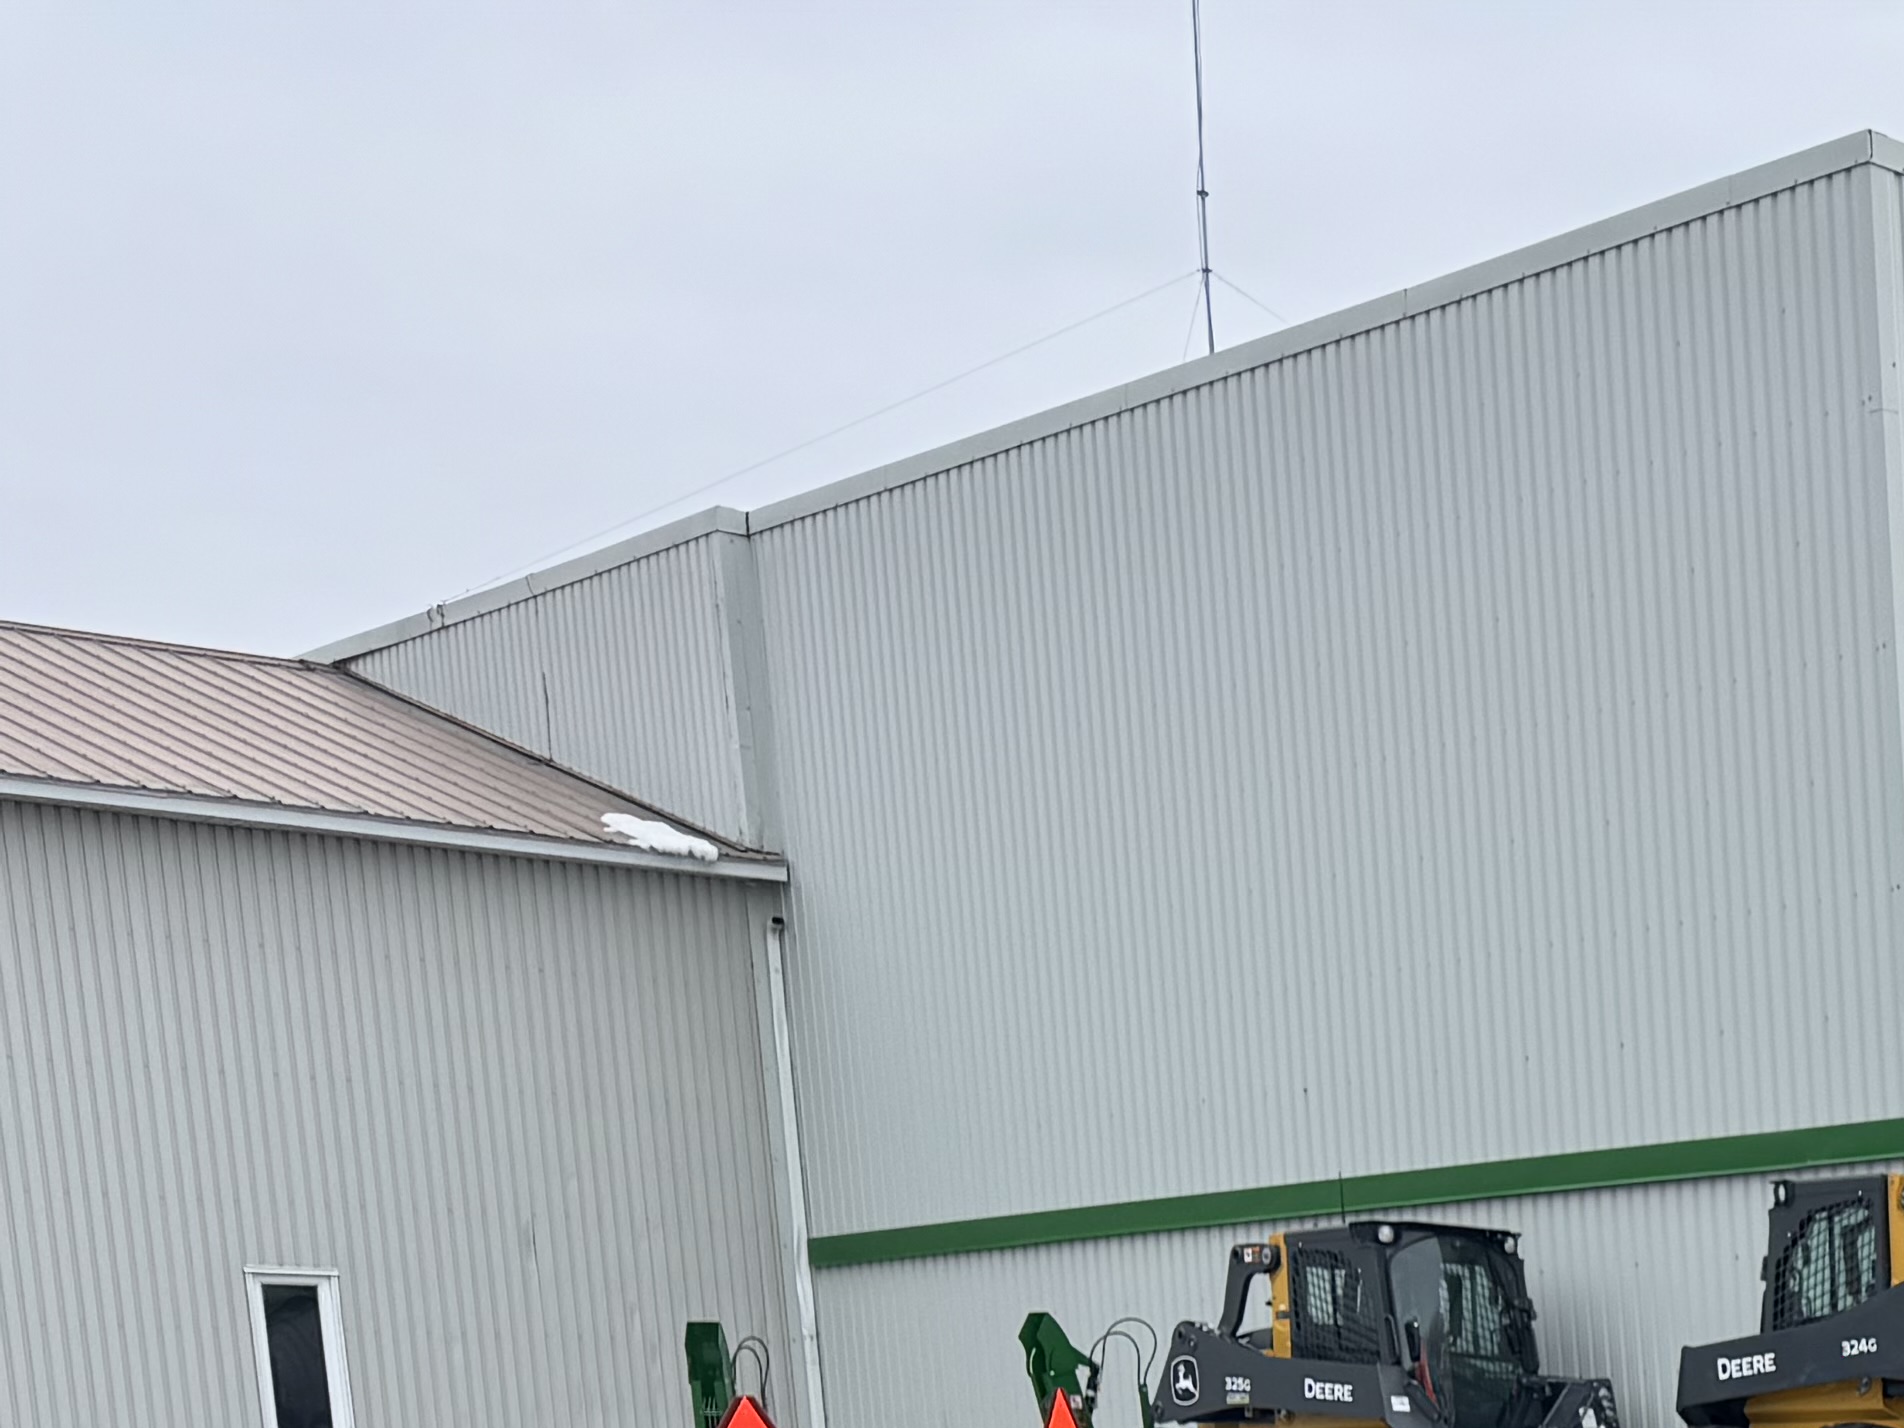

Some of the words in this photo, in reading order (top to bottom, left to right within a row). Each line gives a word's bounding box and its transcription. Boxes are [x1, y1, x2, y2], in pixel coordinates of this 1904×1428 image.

[1841, 1337, 1878, 1357] 324G
[1717, 1352, 1777, 1381] DEERE
[1304, 1377, 1353, 1402] DEERE
